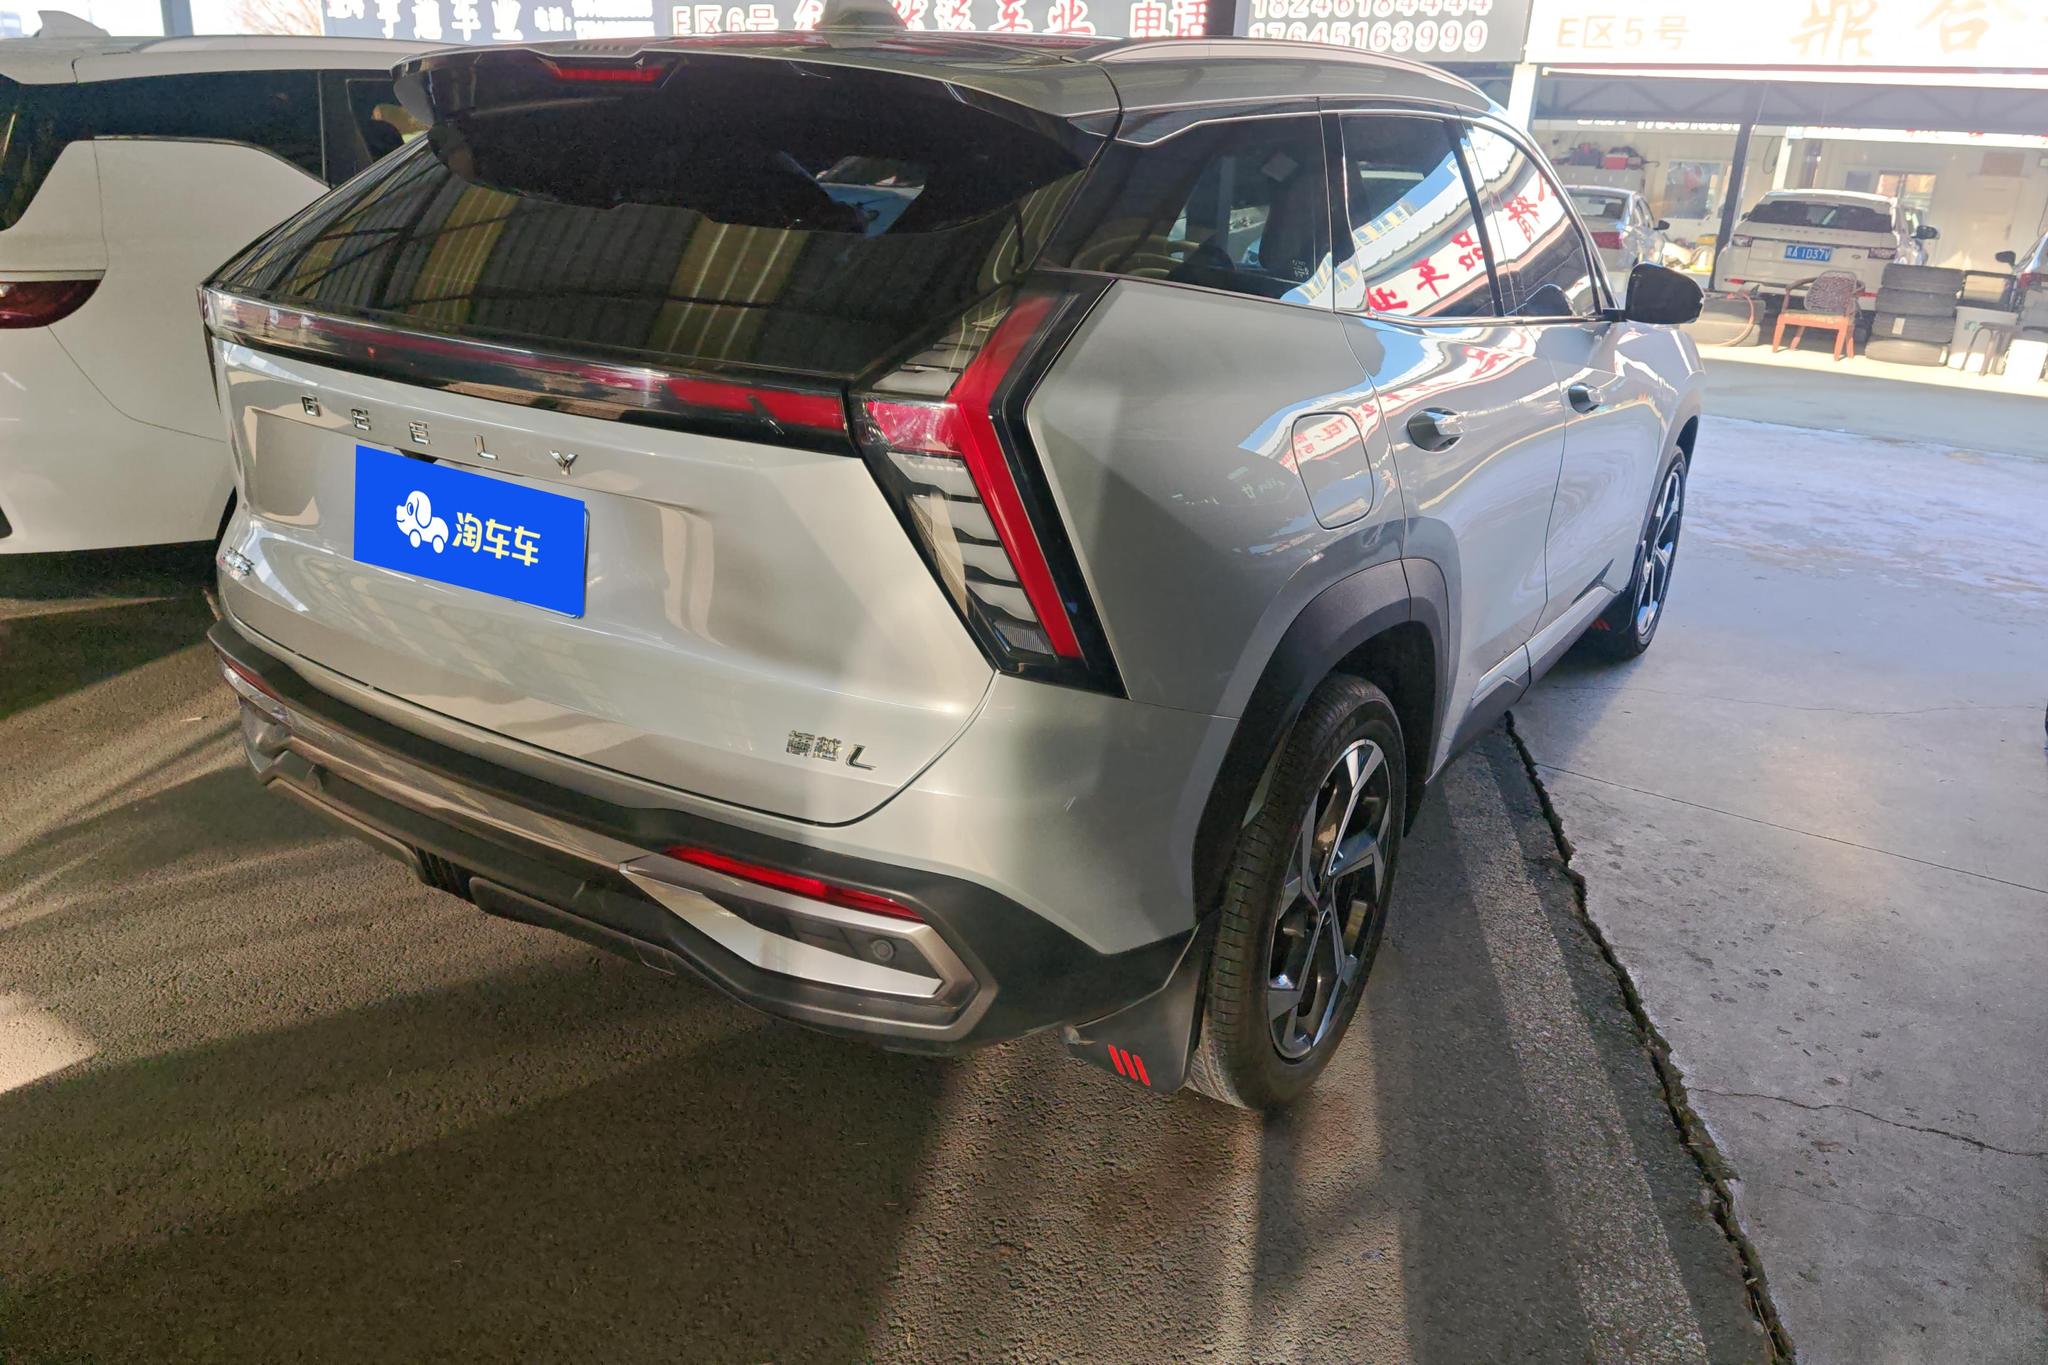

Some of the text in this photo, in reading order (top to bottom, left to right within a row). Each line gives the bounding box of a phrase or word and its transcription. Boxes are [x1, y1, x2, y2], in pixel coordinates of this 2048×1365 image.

[1129, 0, 1207, 37] 电话
[1556, 15, 1691, 50] E区5号
[301, 395, 578, 475] GEELY
